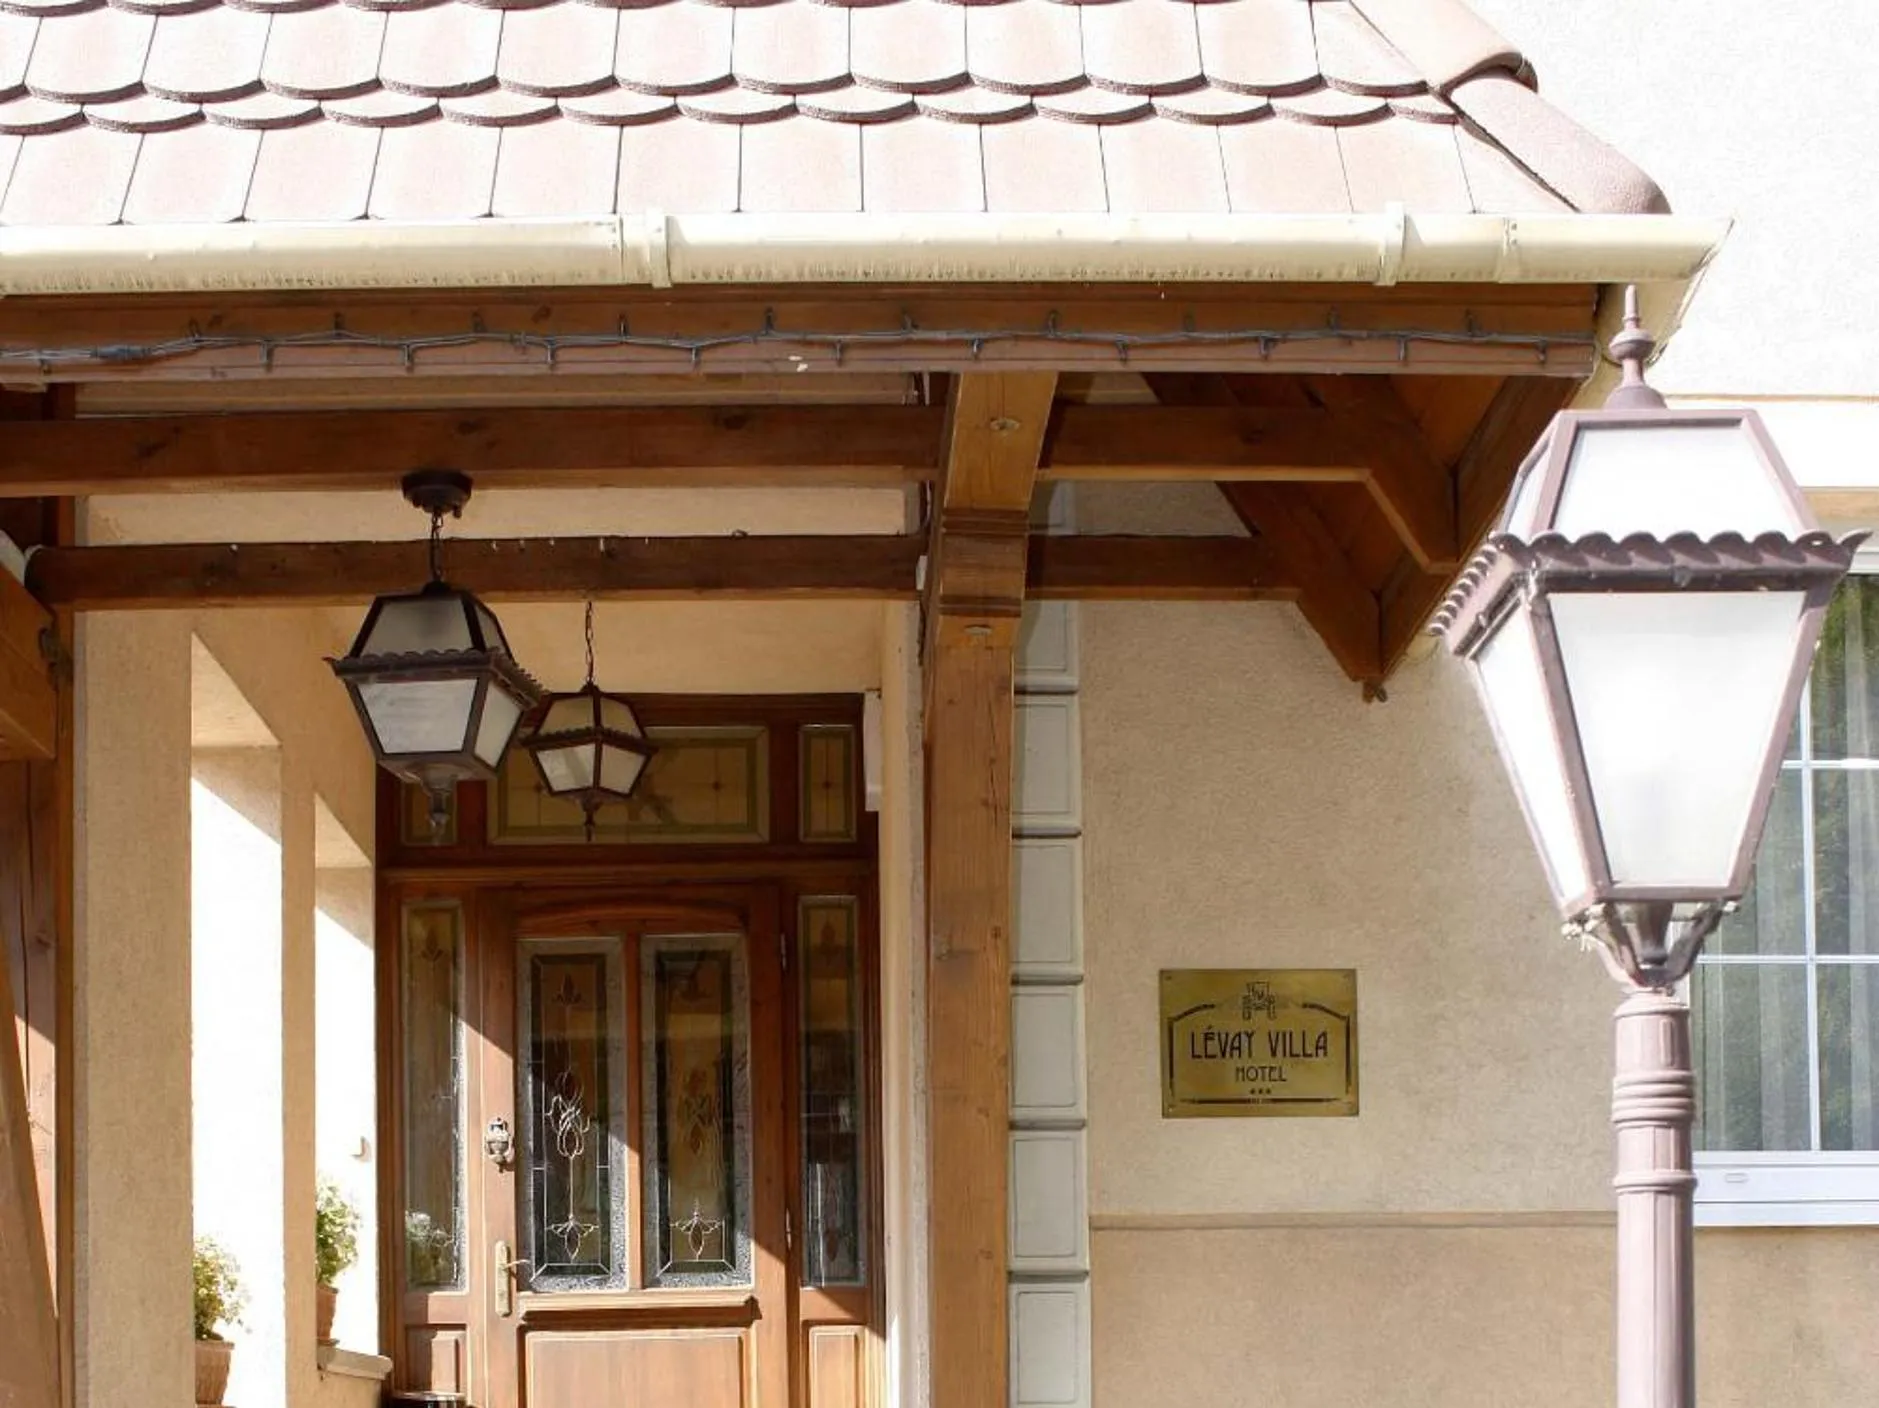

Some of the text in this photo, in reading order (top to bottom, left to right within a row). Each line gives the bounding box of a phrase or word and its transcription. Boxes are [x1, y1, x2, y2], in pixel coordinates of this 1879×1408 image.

[1190, 1025, 1328, 1060] LÉVAY VILLA
[1235, 1066, 1287, 1082] HOTEL
